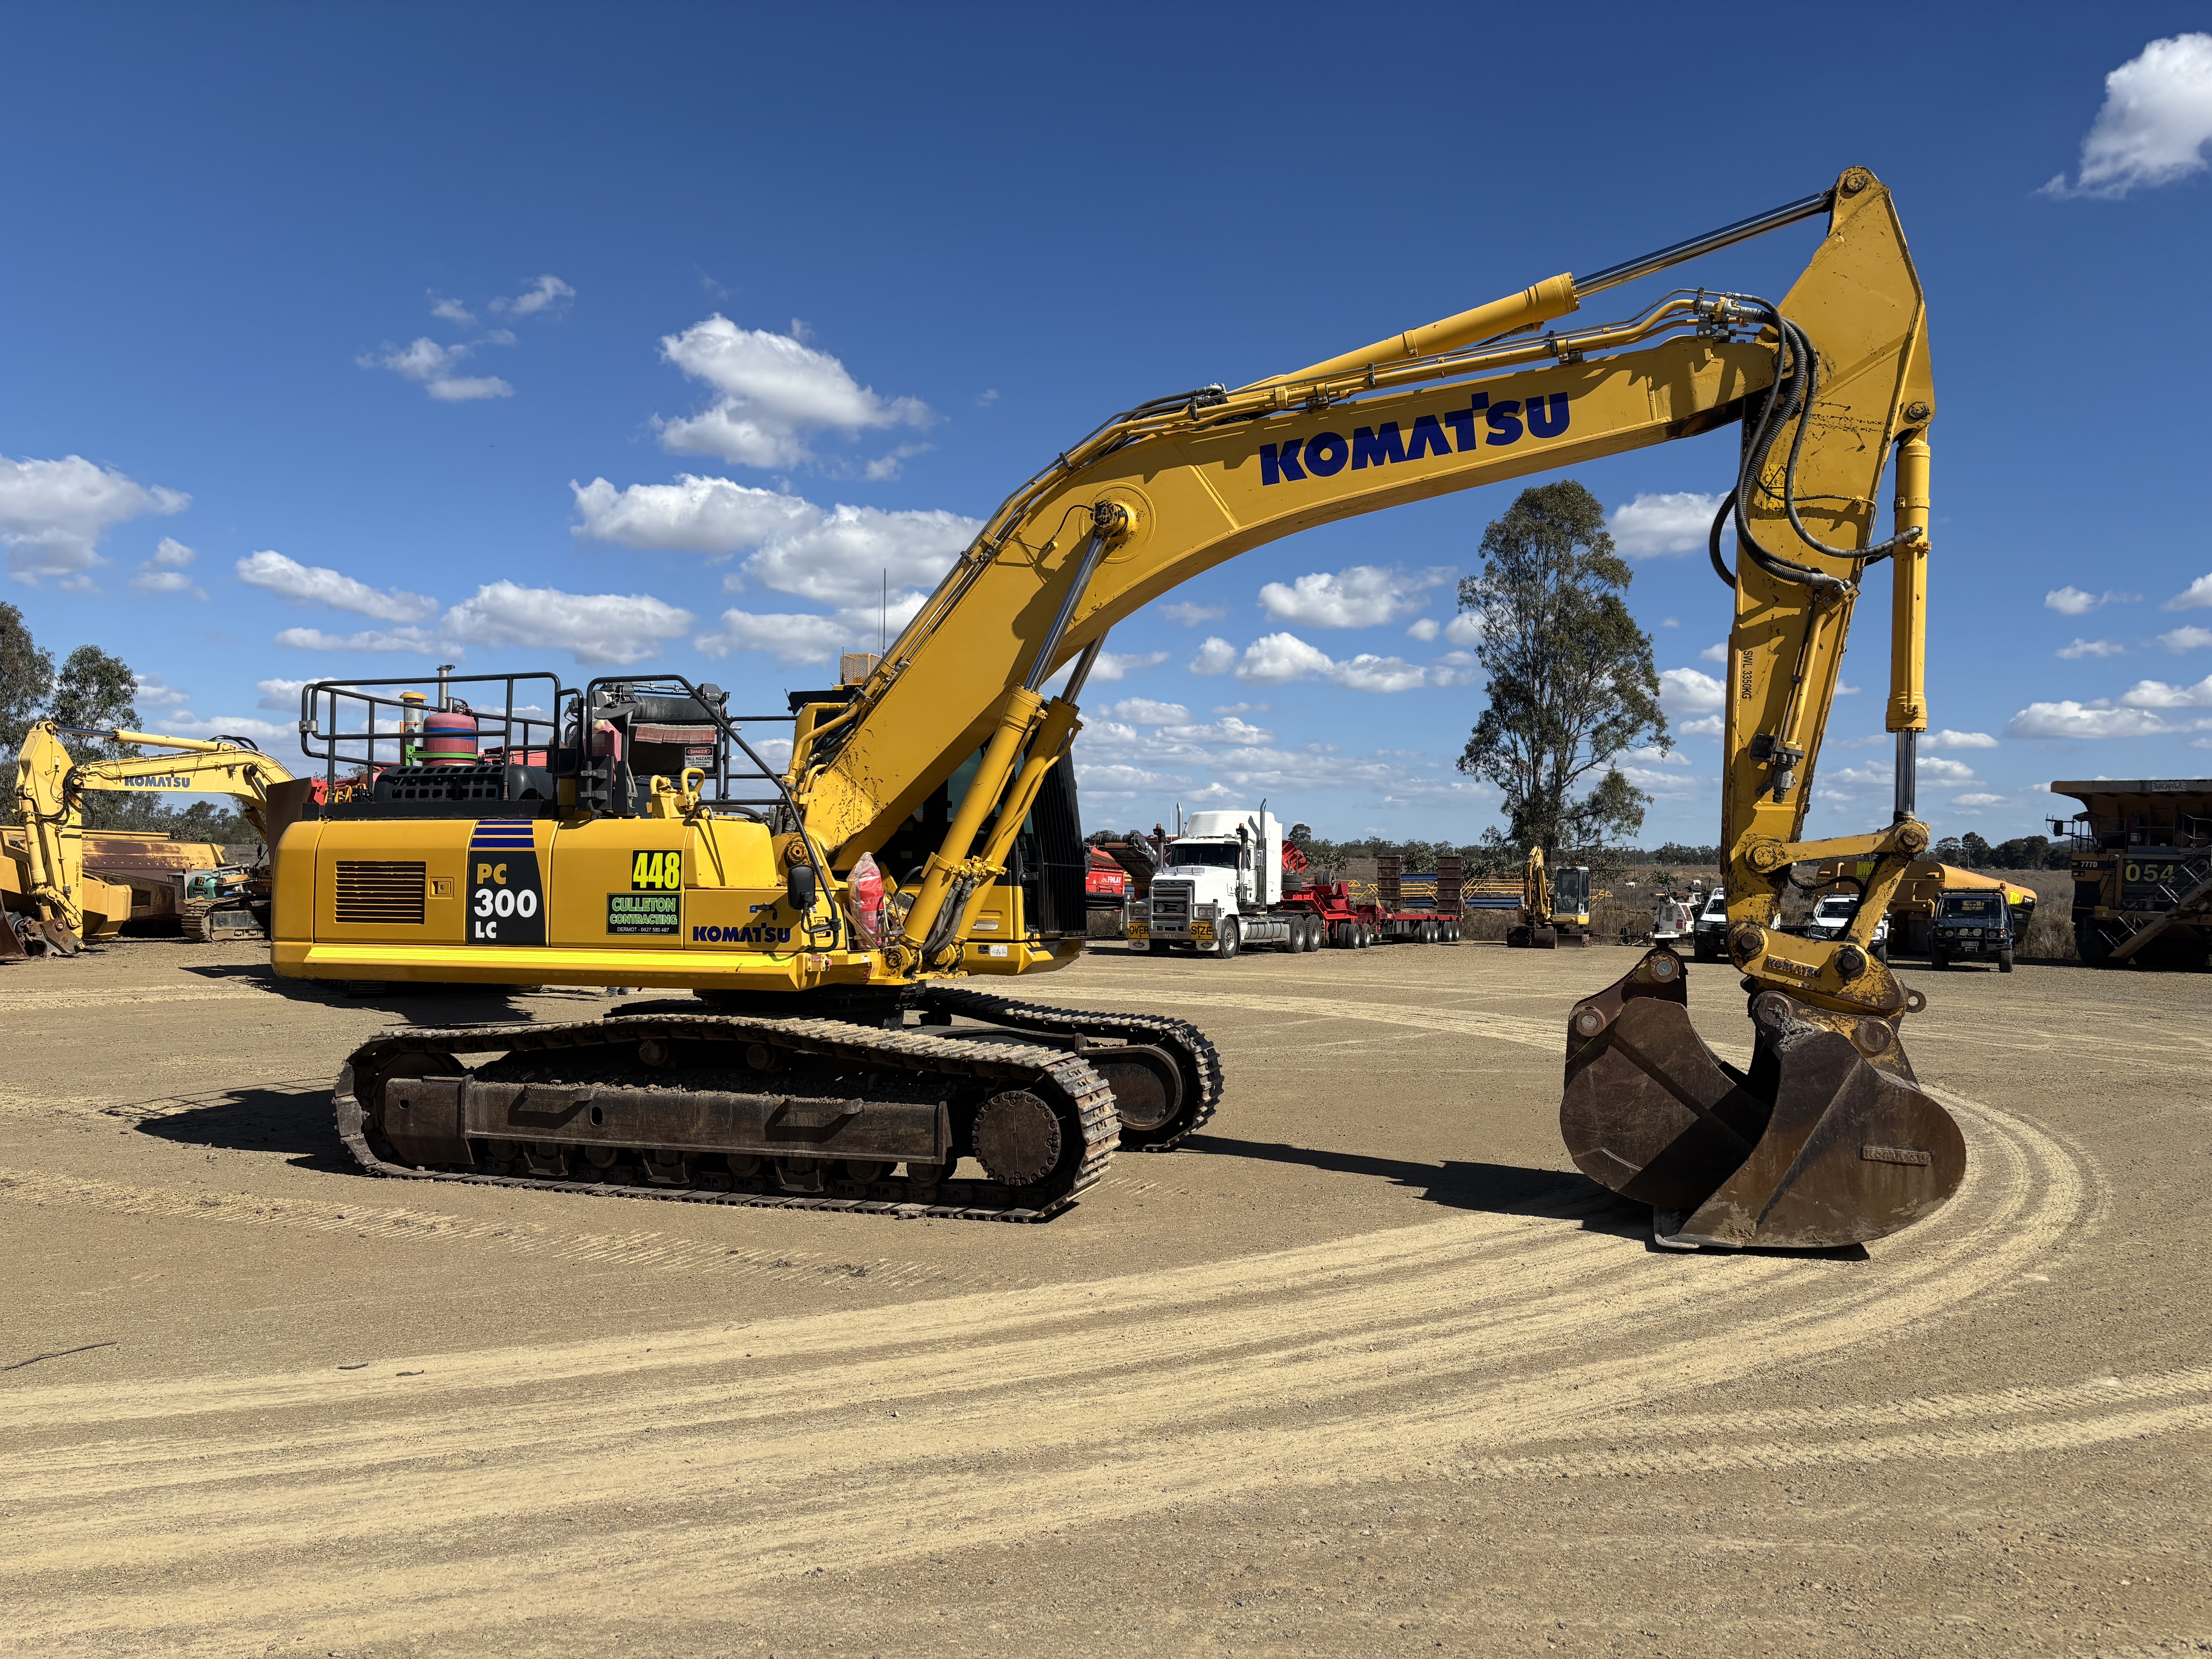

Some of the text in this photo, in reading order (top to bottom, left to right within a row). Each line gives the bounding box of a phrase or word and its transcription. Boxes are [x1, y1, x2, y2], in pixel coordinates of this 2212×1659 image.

[1259, 392, 1570, 486] KOMATSU
[1741, 650, 1753, 699] SWL 3350KG
[124, 774, 191, 788] KOMATSU
[477, 863, 507, 884] PC
[633, 852, 680, 889] 448
[2125, 864, 2175, 883] 054
[474, 888, 537, 917] 300
[612, 897, 676, 912] CULLETON
[610, 914, 678, 925] CONTRACTING
[476, 921, 497, 939] LC
[693, 922, 791, 943] KOMATSU
[1129, 926, 1149, 935] OVER
[1191, 926, 1212, 935] SIZE
[1768, 957, 1823, 979] KOMATSU
[1865, 1148, 1929, 1163] KOMATSU
